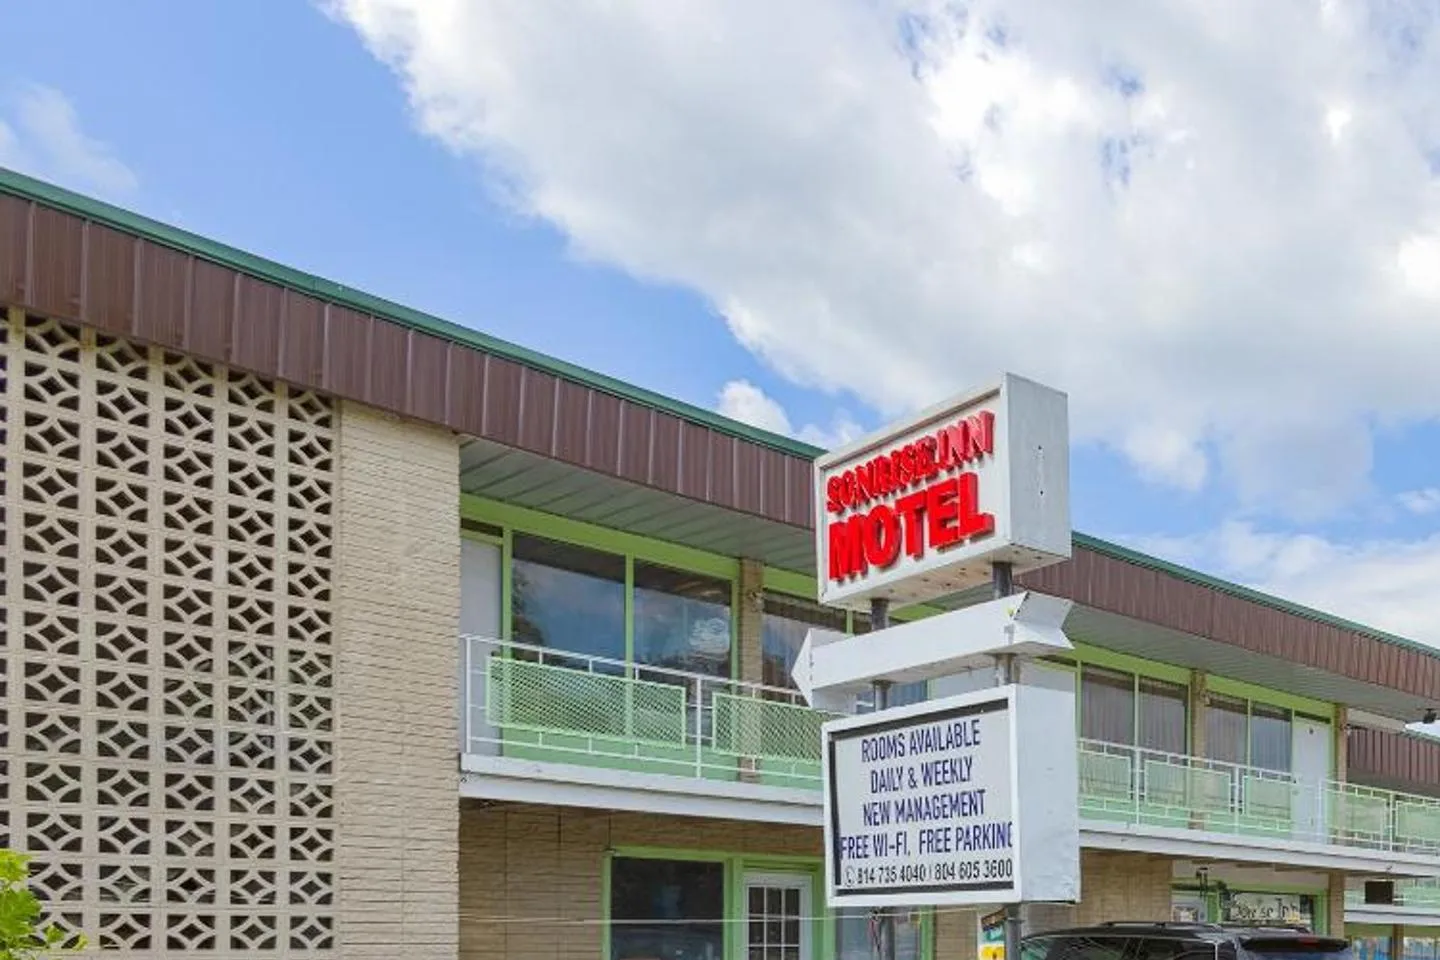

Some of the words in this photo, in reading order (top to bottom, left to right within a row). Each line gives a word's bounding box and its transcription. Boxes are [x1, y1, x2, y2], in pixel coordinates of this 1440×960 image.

[938, 410, 995, 470] INN
[828, 472, 996, 581] MOTEL
[861, 732, 905, 763] ROOMS
[909, 719, 981, 755] AVAILABLE
[870, 766, 903, 794] DAILY
[908, 768, 918, 788] &
[921, 756, 973, 787] WEEKLY
[863, 801, 891, 826] NEW
[894, 789, 986, 824] MANAGEMENT
[840, 836, 869, 861] FREE
[919, 827, 951, 854] FREE
[900, 864, 926, 882] 4040
[934, 860, 955, 881] 804
